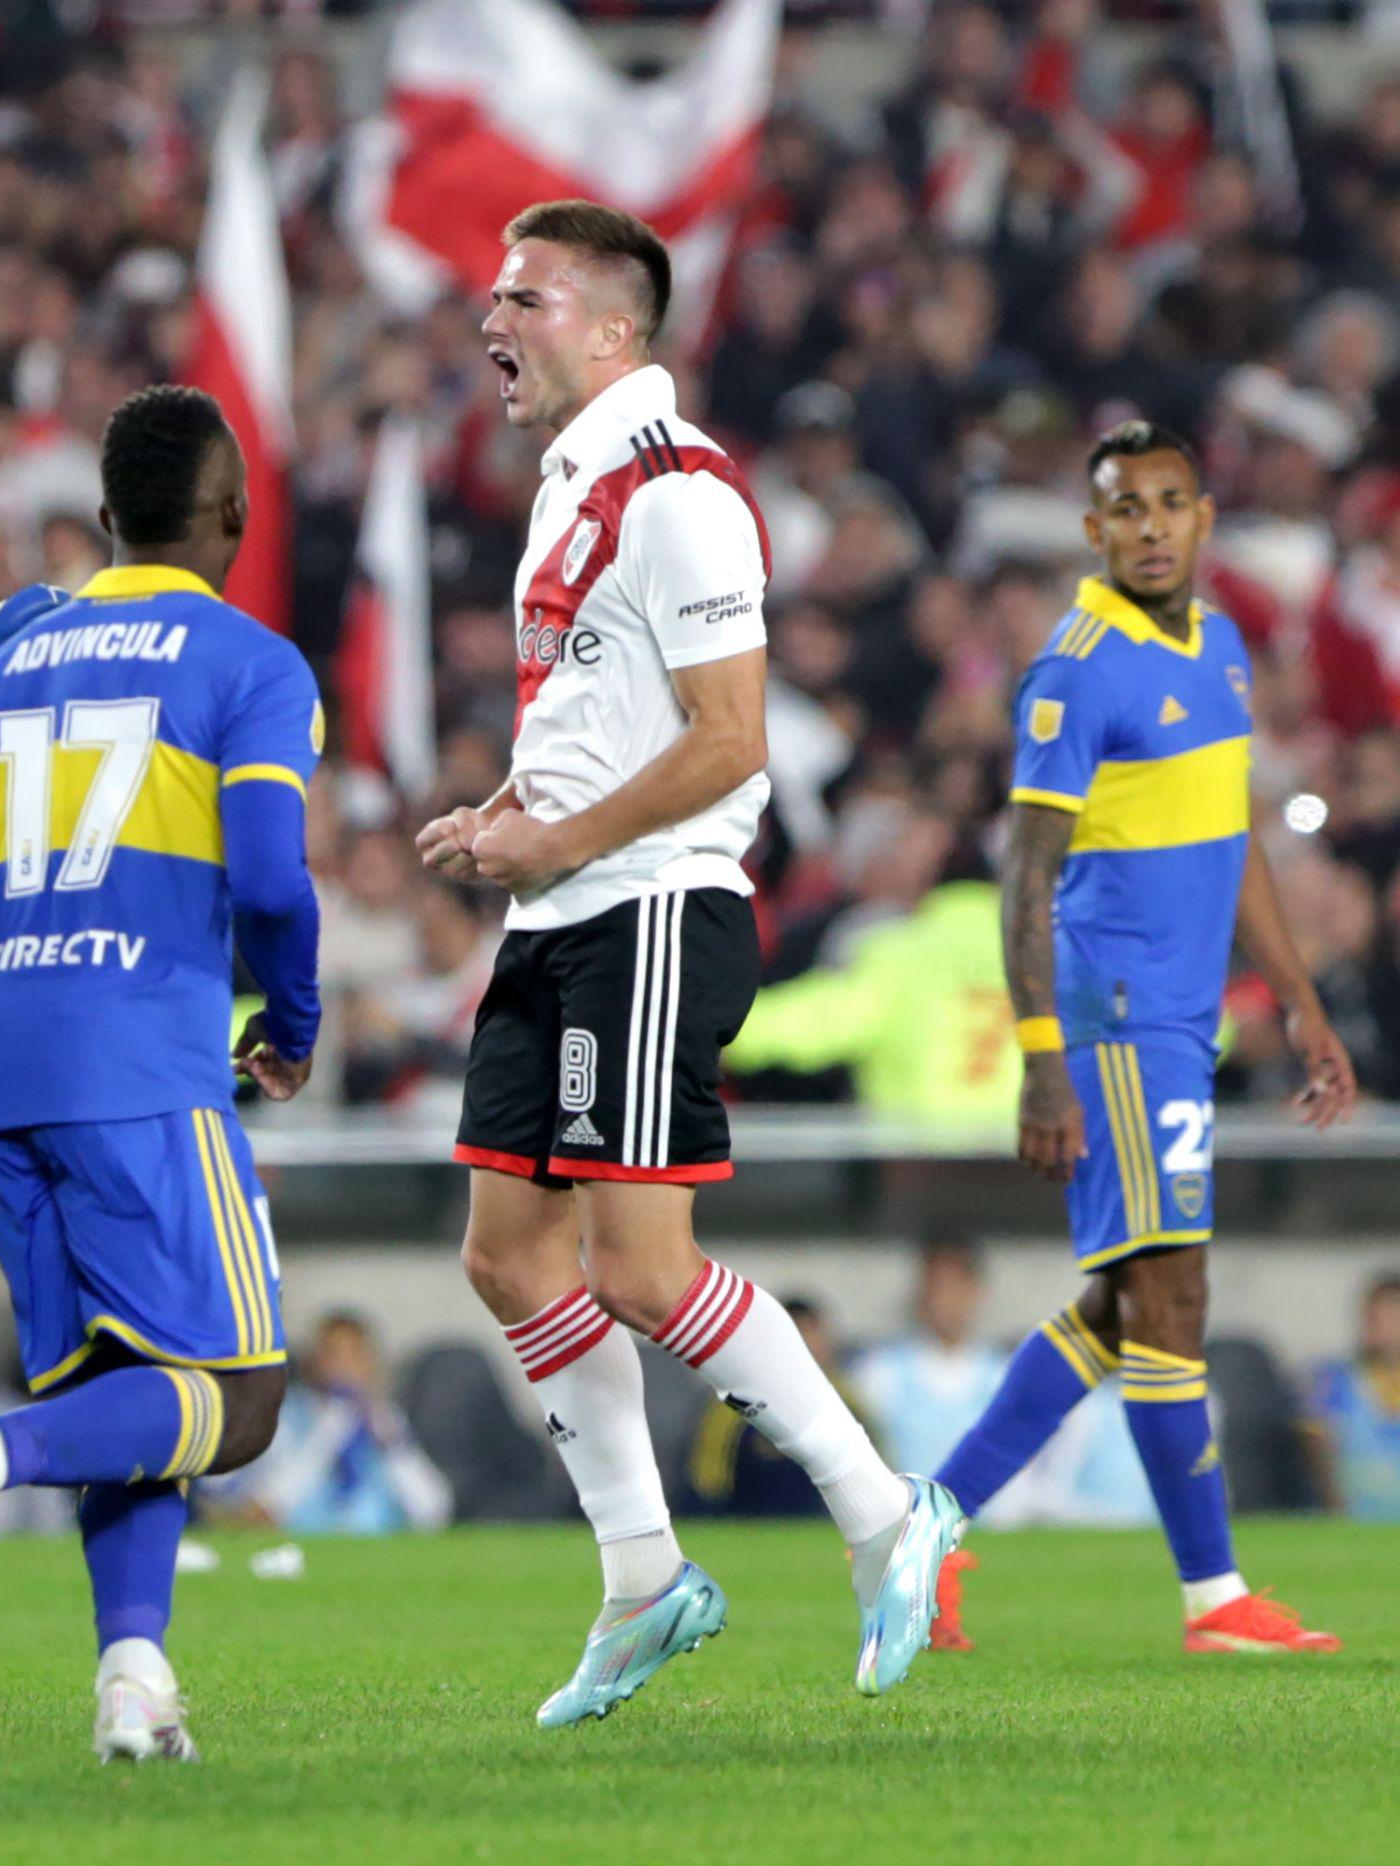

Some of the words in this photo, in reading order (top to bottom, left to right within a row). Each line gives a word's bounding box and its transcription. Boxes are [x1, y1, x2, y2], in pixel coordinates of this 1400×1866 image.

[679, 590, 746, 618] ASSIST
[705, 602, 752, 624] CARD
[3, 621, 189, 676] ADVINCULA
[560, 1028, 598, 1112] 8
